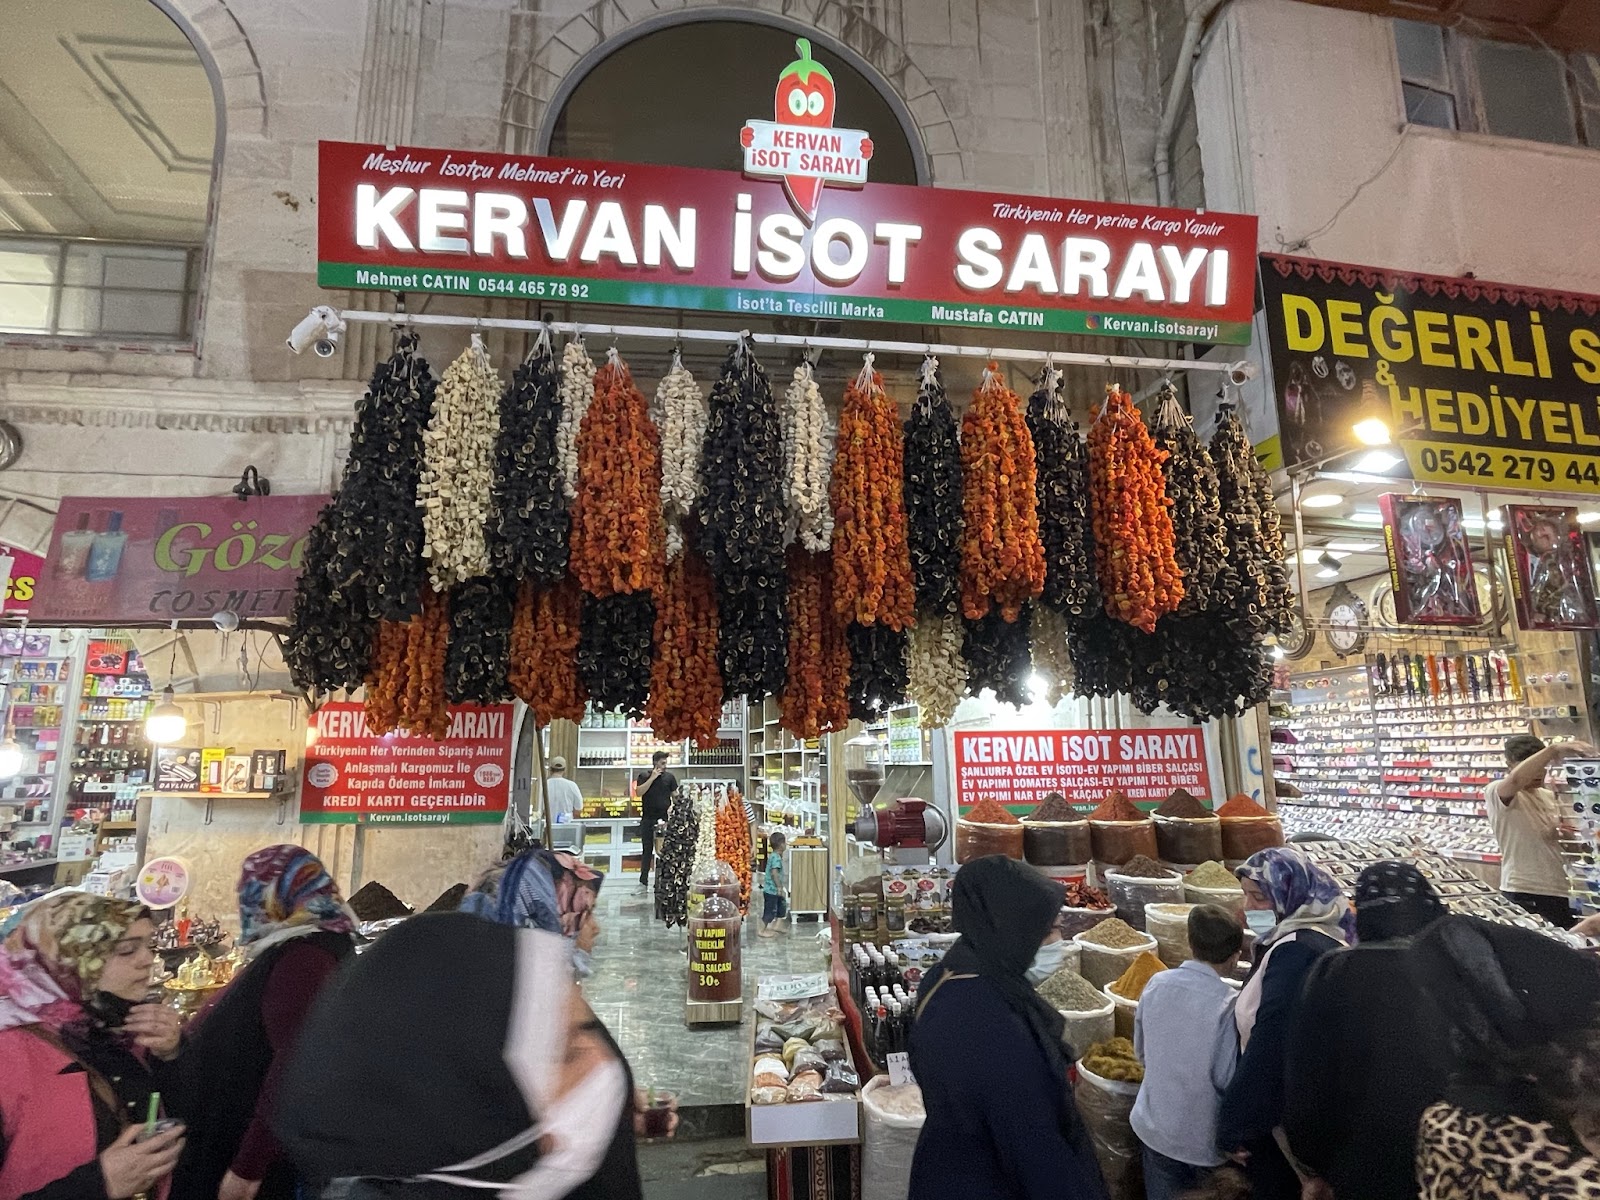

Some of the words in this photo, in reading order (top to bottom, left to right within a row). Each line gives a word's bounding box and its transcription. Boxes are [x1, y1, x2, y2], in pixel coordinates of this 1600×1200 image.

[773, 130, 841, 153] KERVAN
[363, 153, 431, 175] Meşhur
[440, 154, 494, 180] İsotçu
[593, 170, 626, 189] Yeri
[800, 153, 860, 175] SARAYI
[992, 203, 1063, 223] Türkiyenin
[1066, 208, 1094, 225] Her
[1094, 213, 1138, 229] yerine
[1141, 216, 1181, 236] Kargo
[1184, 218, 1225, 238] Yapılır
[355, 184, 698, 271] KERVAN
[733, 192, 922, 285] İSOT
[954, 227, 1230, 307] SARAYI
[356, 270, 418, 287] Mehmet
[422, 274, 470, 291] CATIN
[478, 277, 514, 293] 0544
[518, 280, 545, 294] 465
[550, 282, 567, 297] 78
[571, 283, 589, 298] 92
[786, 299, 838, 315] Tescilli
[841, 302, 885, 318] Marka
[931, 306, 993, 323] Mustafa
[998, 309, 1044, 326] CATIN
[1103, 317, 1219, 340] Kervan.isotsarayi
[1281, 291, 1553, 379] DEĞERLİ
[1389, 384, 1600, 447] HEDİYEL
[1421, 448, 1494, 477] 0542
[1504, 454, 1555, 482] 279
[1565, 460, 1600, 485] 44
[314, 745, 367, 758] Türkiyenin
[370, 745, 389, 756] Her
[391, 745, 435, 756] Yerinden
[438, 745, 474, 758] Sipariş
[476, 745, 504, 756] Alınır
[962, 736, 1054, 762] KERVAN
[1119, 734, 1198, 761] SARAYI
[344, 762, 398, 775] Anlaşmalı
[401, 763, 453, 775] Kargomuz
[961, 766, 1013, 778] ŞANLIURFA
[1015, 764, 1039, 776] ÖZEL
[1041, 765, 1053, 775] EV
[1101, 764, 1134, 774] YAPIMI
[1136, 762, 1163, 773] BİBER
[1165, 763, 1203, 775] SALÇASI
[347, 779, 385, 791] Kapıda
[388, 776, 425, 789] Ödeme
[428, 776, 466, 789] İmkanı
[962, 779, 974, 789] EV
[976, 779, 1010, 788] YAPIMI
[1013, 777, 1058, 788] DOMATES
[1060, 776, 1114, 789] SALÇASI-EV
[1116, 776, 1149, 785] YAPIMI
[1151, 775, 1169, 785] PUL
[1171, 773, 1198, 785] BİBER
[323, 793, 362, 807] KREDİ
[367, 795, 405, 806] KARTI
[410, 792, 486, 809] GEÇERLİDİR
[963, 791, 974, 802] EV
[1014, 791, 1034, 800] NAR
[1128, 787, 1147, 798] KREDİ
[1148, 788, 1167, 798] KARTI
[704, 928, 726, 938] YAPIMI
[701, 952, 718, 961] TATLI
